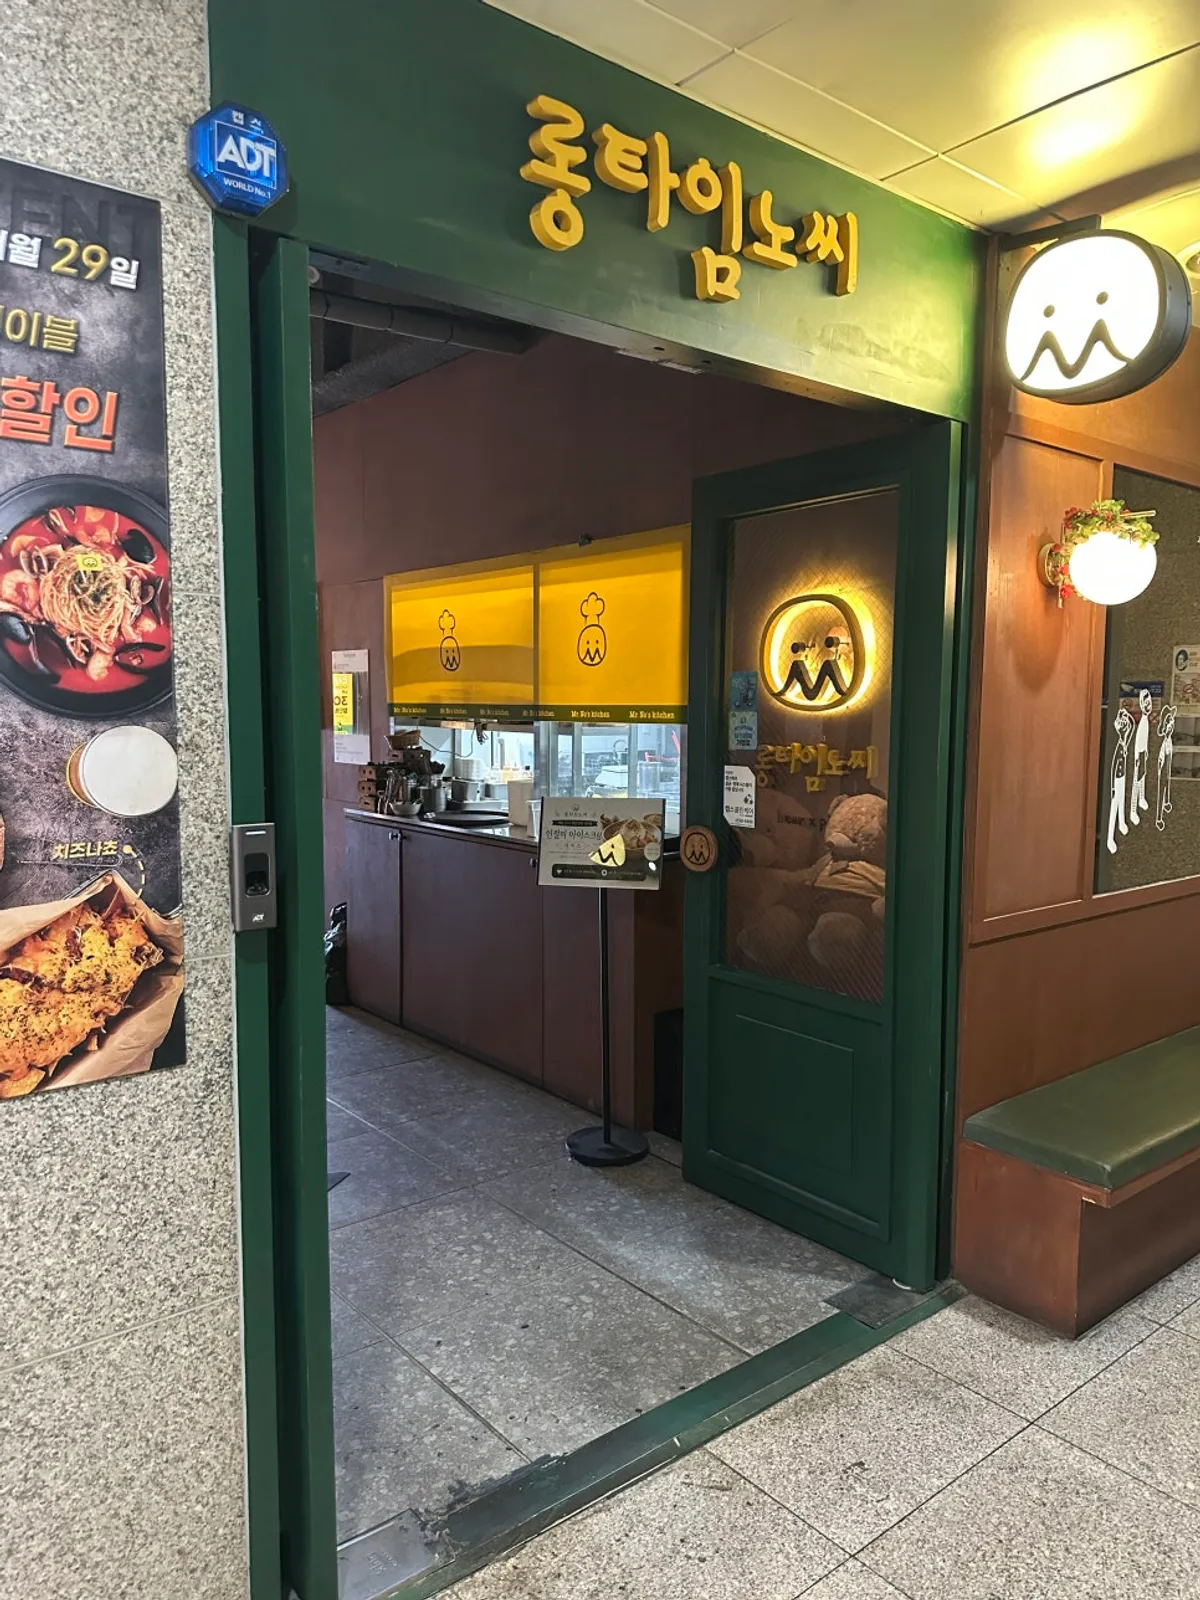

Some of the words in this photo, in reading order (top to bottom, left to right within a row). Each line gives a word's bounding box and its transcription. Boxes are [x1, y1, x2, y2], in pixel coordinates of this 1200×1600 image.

[217, 134, 276, 178] ADT
[223, 177, 254, 193] WORLD
[254, 187, 271, 199] No.1
[519, 94, 859, 303] 롱타임노씨
[50, 236, 140, 291] 29일
[0, 305, 79, 354] 이블
[0, 375, 119, 453] 할인
[54, 840, 118, 861] 치즈나쵸
